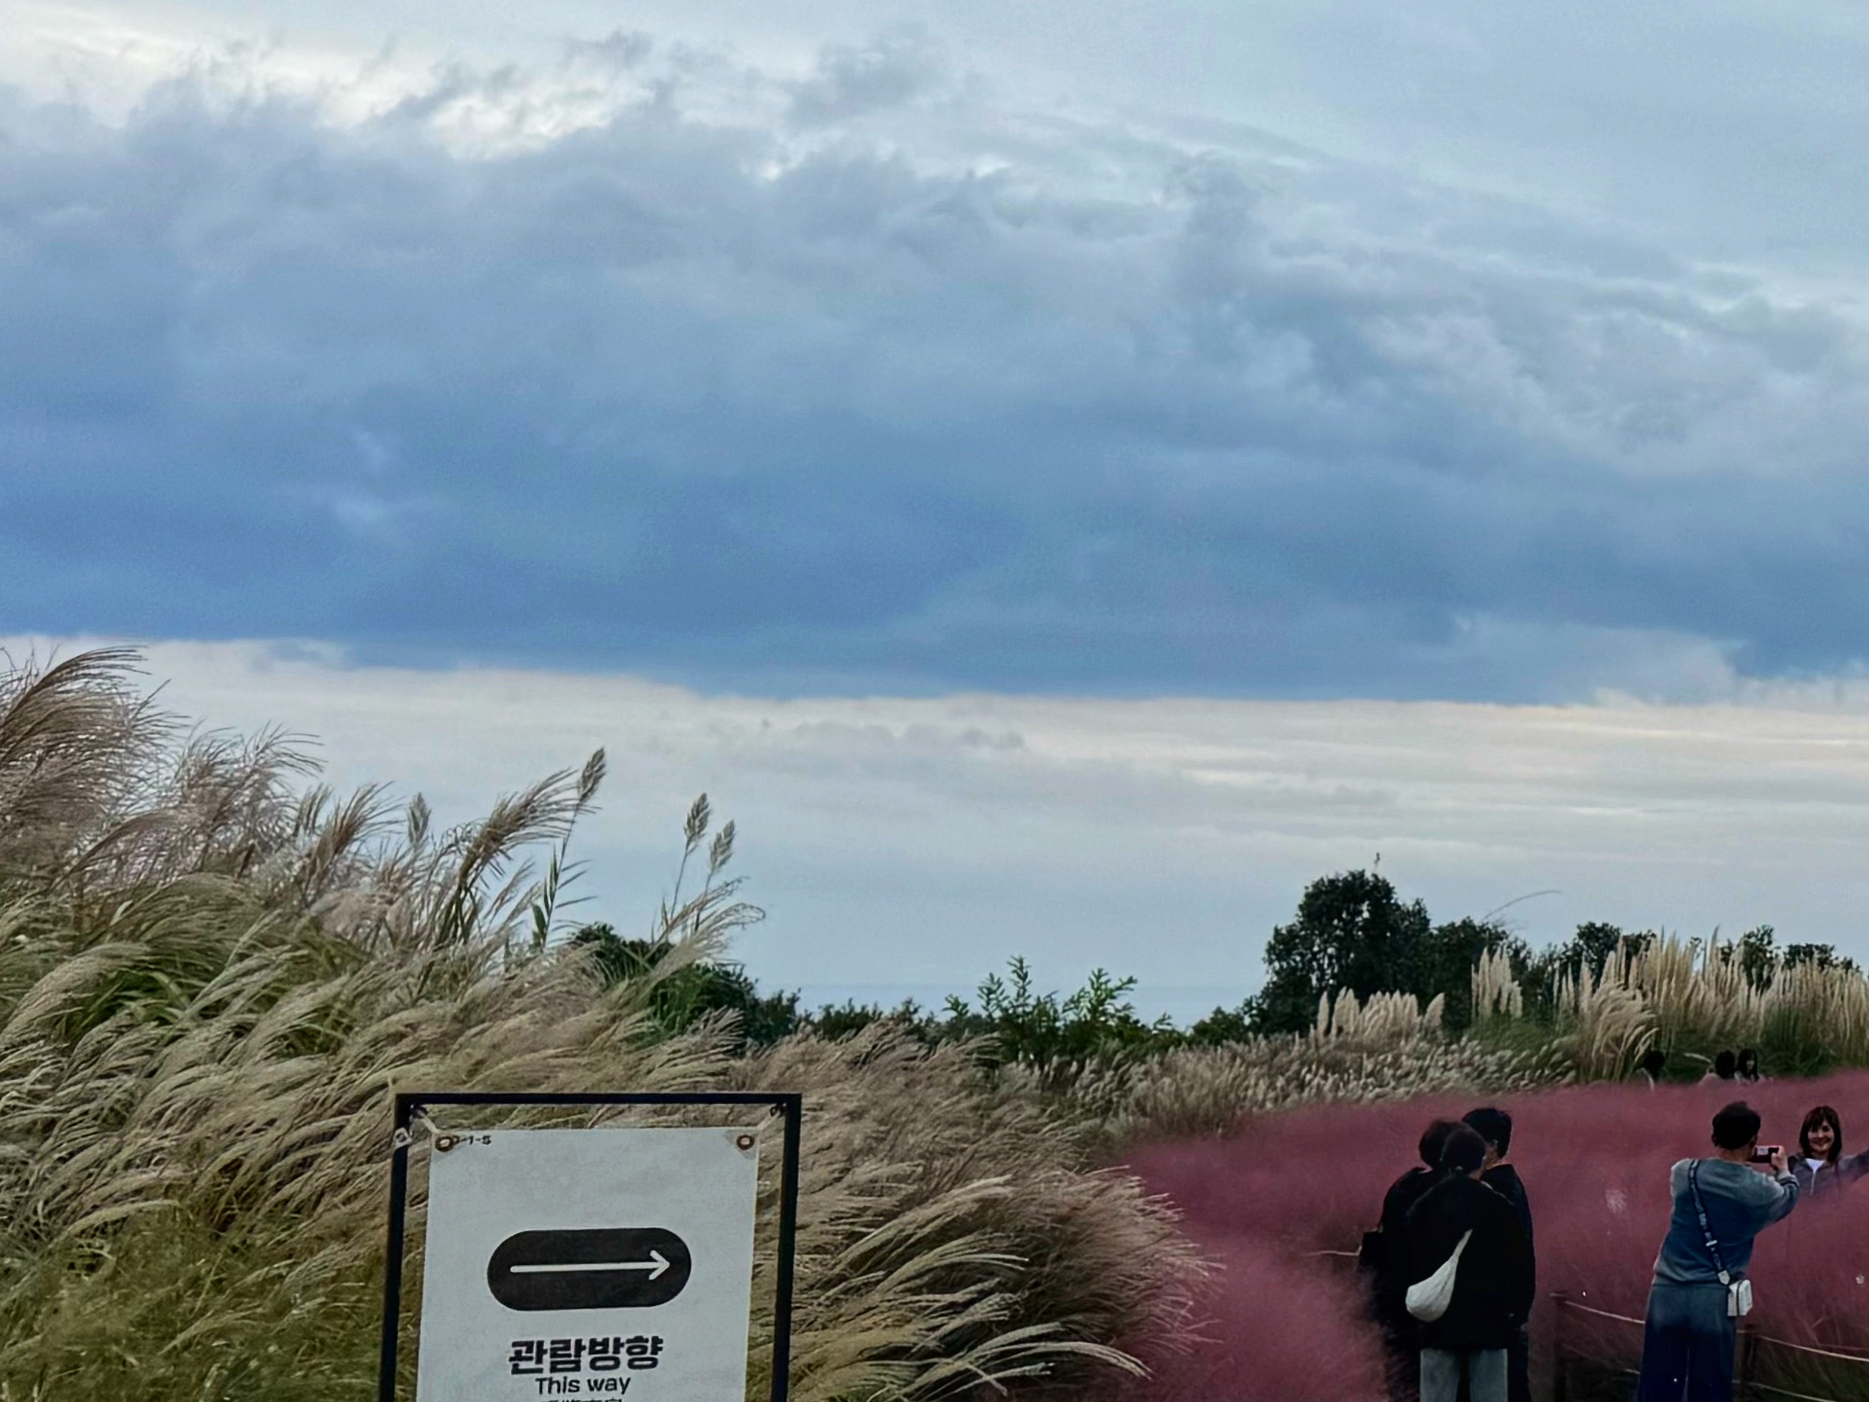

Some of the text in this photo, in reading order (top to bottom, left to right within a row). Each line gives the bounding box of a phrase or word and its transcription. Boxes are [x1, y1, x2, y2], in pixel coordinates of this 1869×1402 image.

[508, 1335, 664, 1375] 관람방향
[535, 1377, 632, 1395] This way
